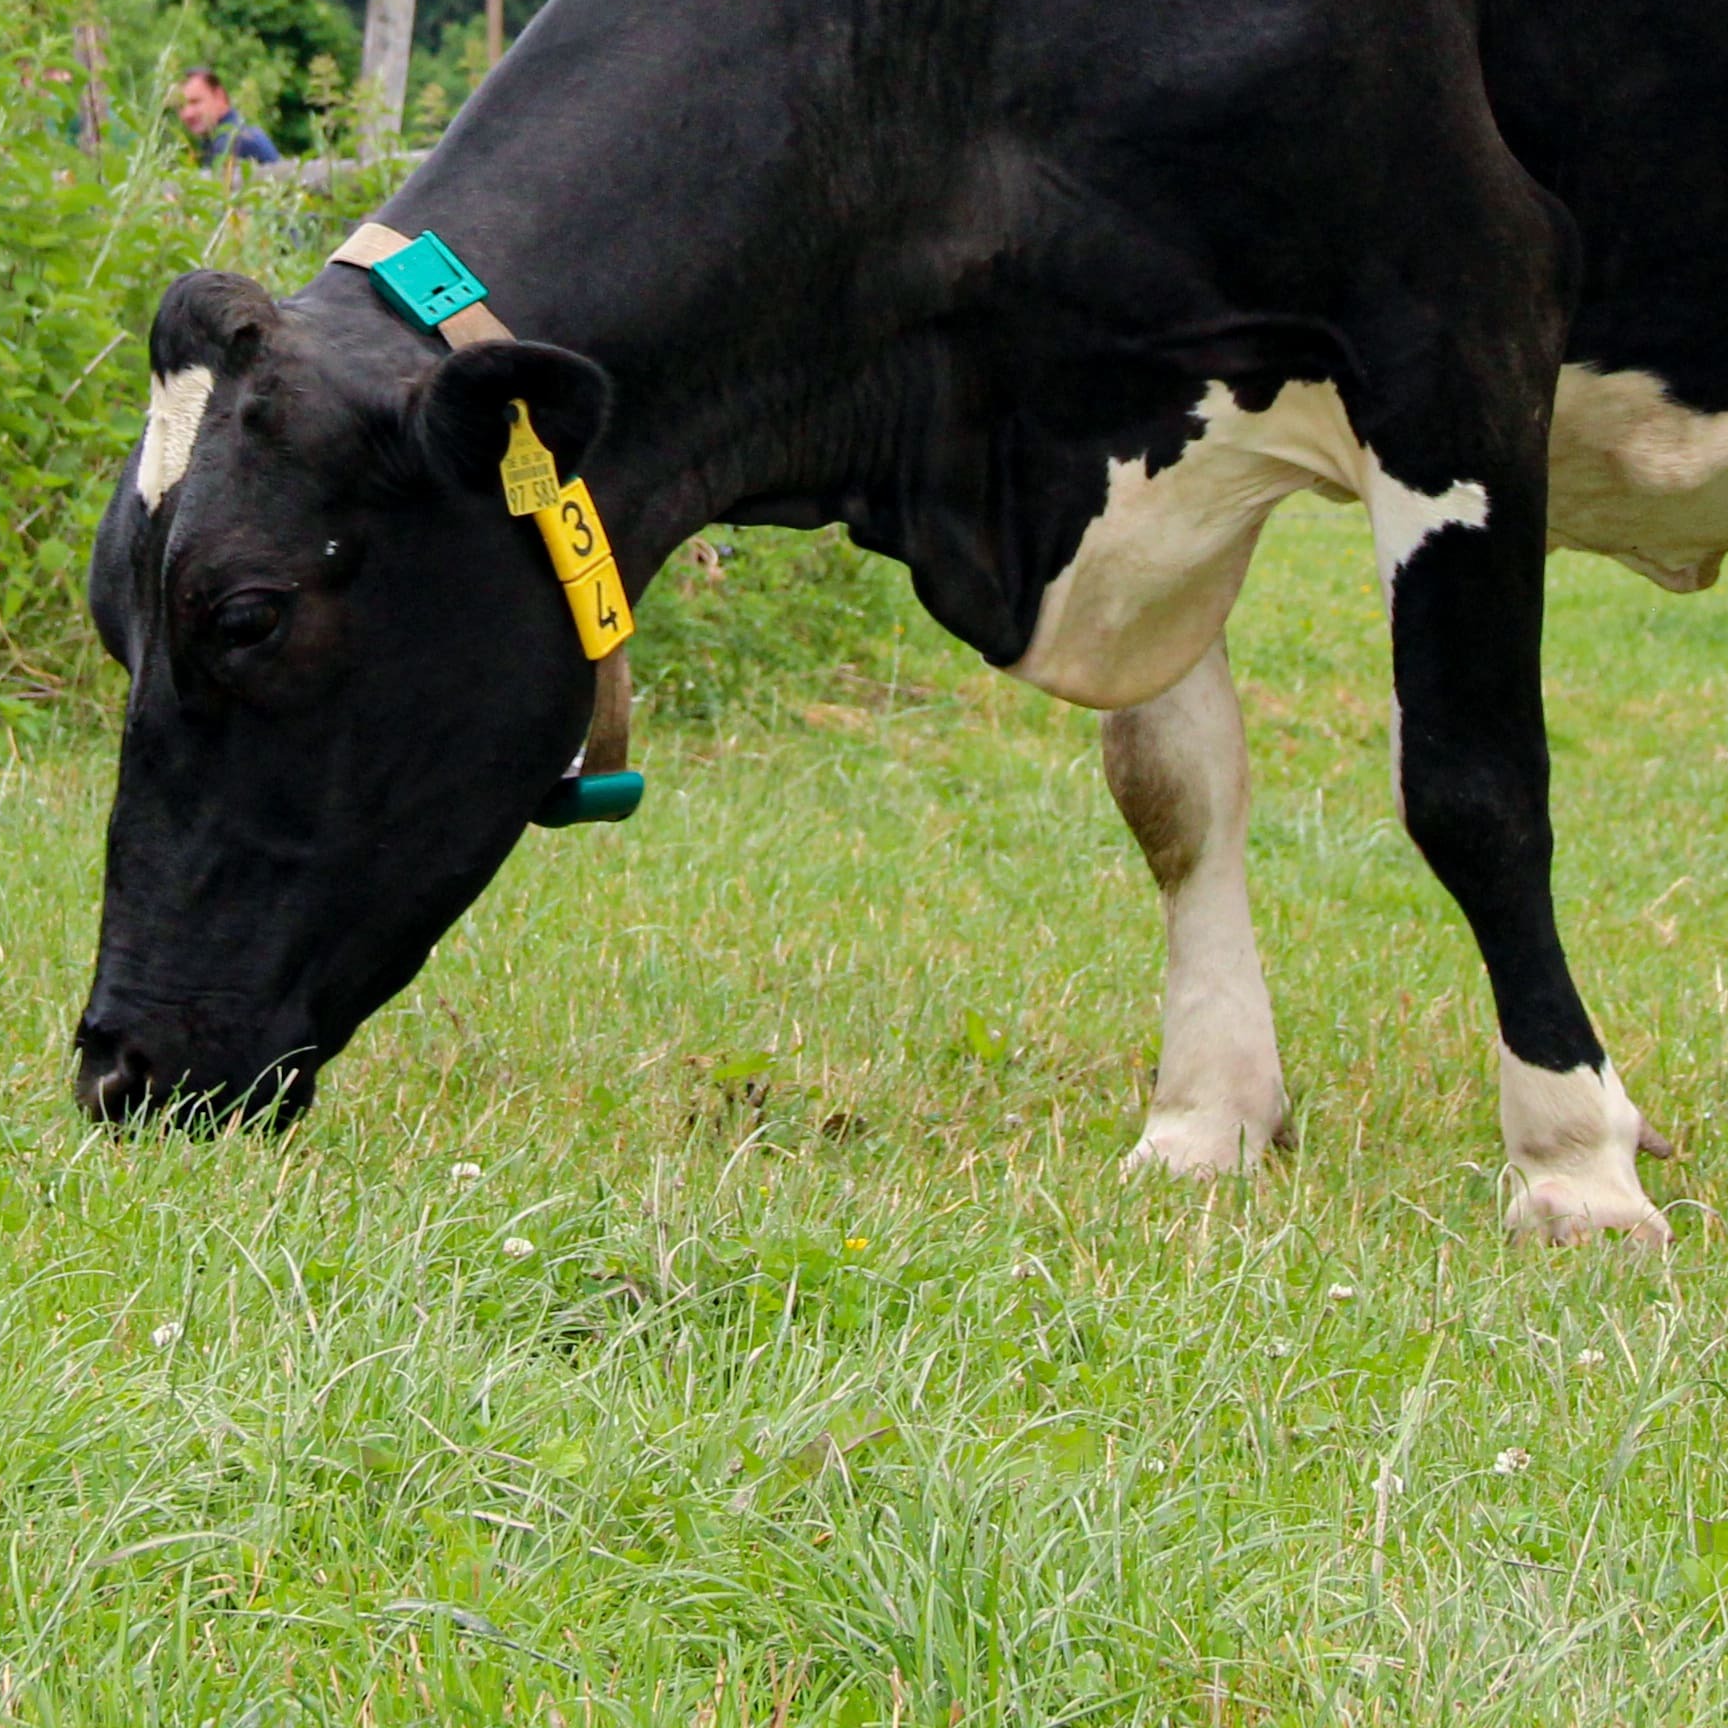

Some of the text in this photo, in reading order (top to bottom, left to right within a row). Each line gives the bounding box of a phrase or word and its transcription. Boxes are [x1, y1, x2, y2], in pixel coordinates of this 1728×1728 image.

[509, 484, 525, 514] 97
[562, 500, 593, 557] 3
[596, 580, 618, 633] 4
